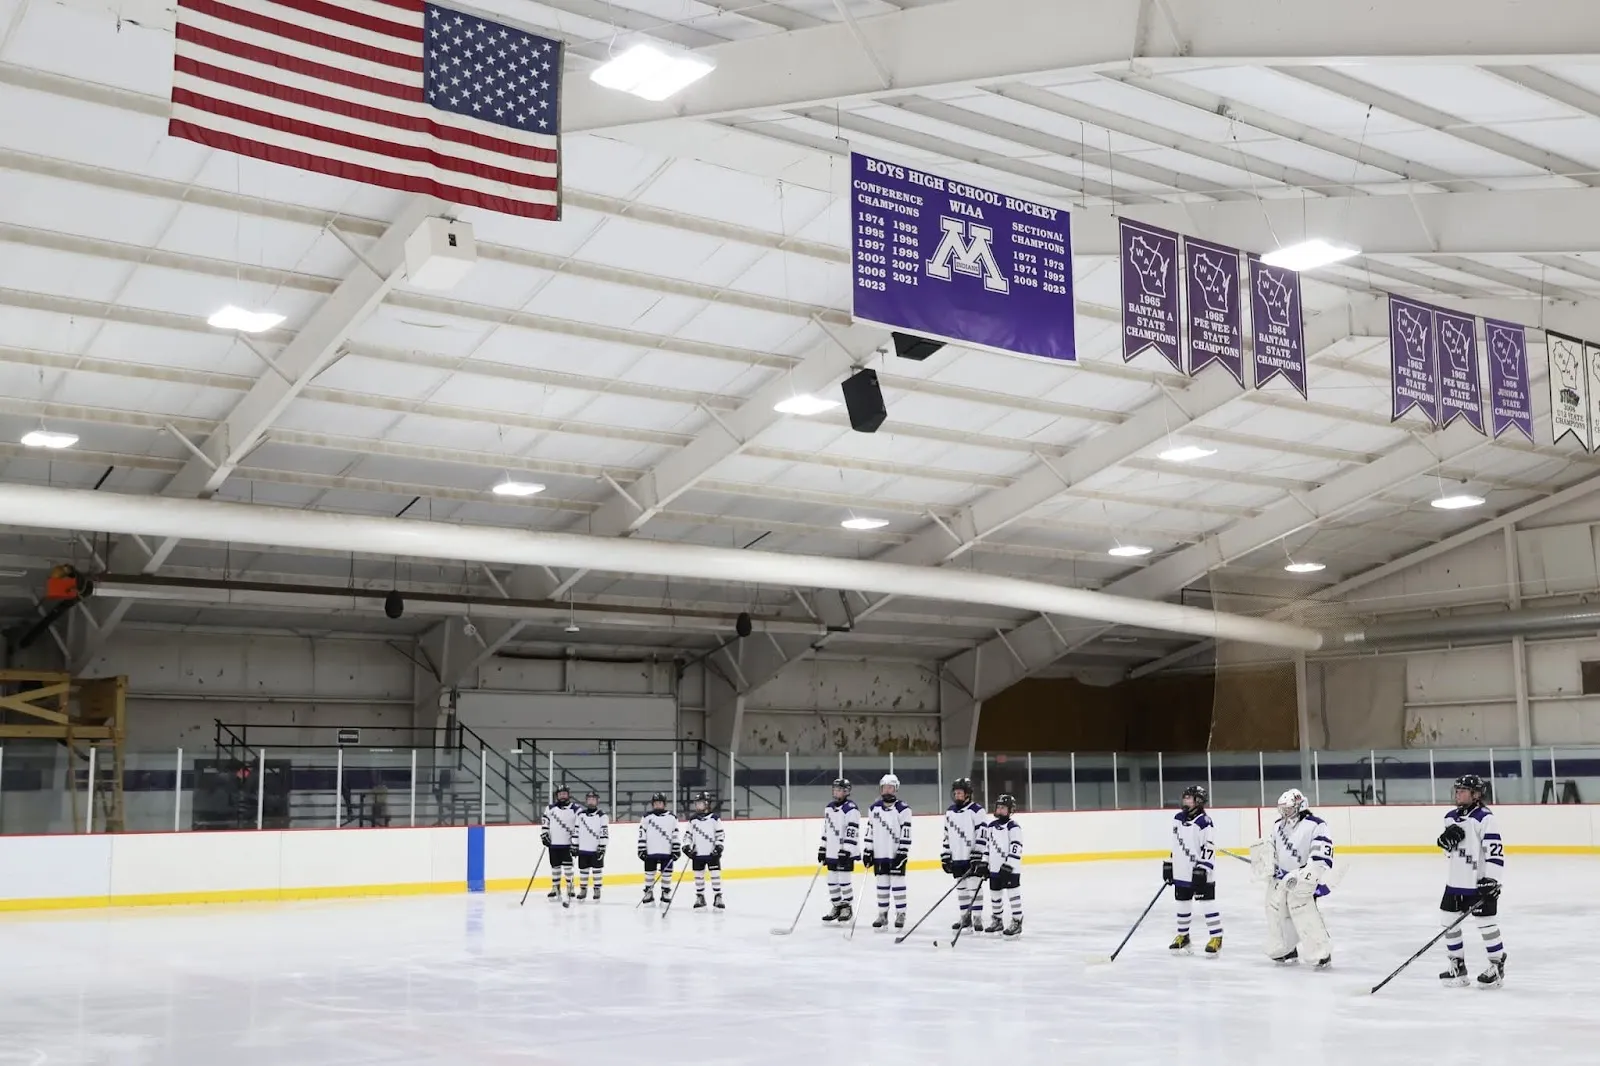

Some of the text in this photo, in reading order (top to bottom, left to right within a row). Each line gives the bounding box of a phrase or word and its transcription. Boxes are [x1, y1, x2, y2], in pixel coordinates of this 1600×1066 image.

[854, 180, 924, 206] CONFERENCE
[866, 158, 1058, 221] BOYS HIGH SCHOOL HOCKEY
[858, 194, 920, 218] CHAMPIONS
[949, 200, 984, 219] WIAA
[858, 212, 918, 234] 1974 1992
[858, 225, 884, 239] 1995
[1012, 222, 1064, 242] SECTIONAL
[858, 238, 885, 252] 1997
[1011, 234, 1065, 254] CHAMPIONS
[857, 251, 919, 273] 2002 2007
[926, 214, 1009, 295] M
[1013, 251, 1064, 271] 1972 1973
[858, 264, 918, 286] 2008 2021
[1013, 263, 1065, 282] 1974 1992
[858, 278, 886, 291] 2023
[1013, 275, 1066, 294] 2008 2023
[1140, 294, 1160, 307] 1965
[1128, 303, 1173, 321] BANTAM A
[1205, 310, 1224, 322] 1965
[1137, 317, 1165, 331] STATE
[1194, 317, 1238, 335] PEE WEE A
[1126, 326, 1176, 345] CHAMPIONS
[1204, 331, 1230, 344] STATE
[1259, 333, 1297, 349] BANTAM A
[1193, 340, 1239, 358] CHAMPIONS
[1266, 346, 1291, 358] STATE
[1257, 355, 1300, 371] CHAMPIONS
[1398, 366, 1411, 377] PEE
[1412, 371, 1427, 381] WEE
[1406, 378, 1426, 390] STATE
[1444, 378, 1475, 392] PEE WEE A
[1397, 386, 1434, 403] CHAMPIONS
[1450, 389, 1470, 400] STATE
[1443, 397, 1478, 411] CHAMPIONS
[1502, 399, 1521, 408] STATE
[1495, 408, 1530, 419] CHAMPIONS
[1202, 849, 1214, 859] 17
[1490, 844, 1503, 856] 22
